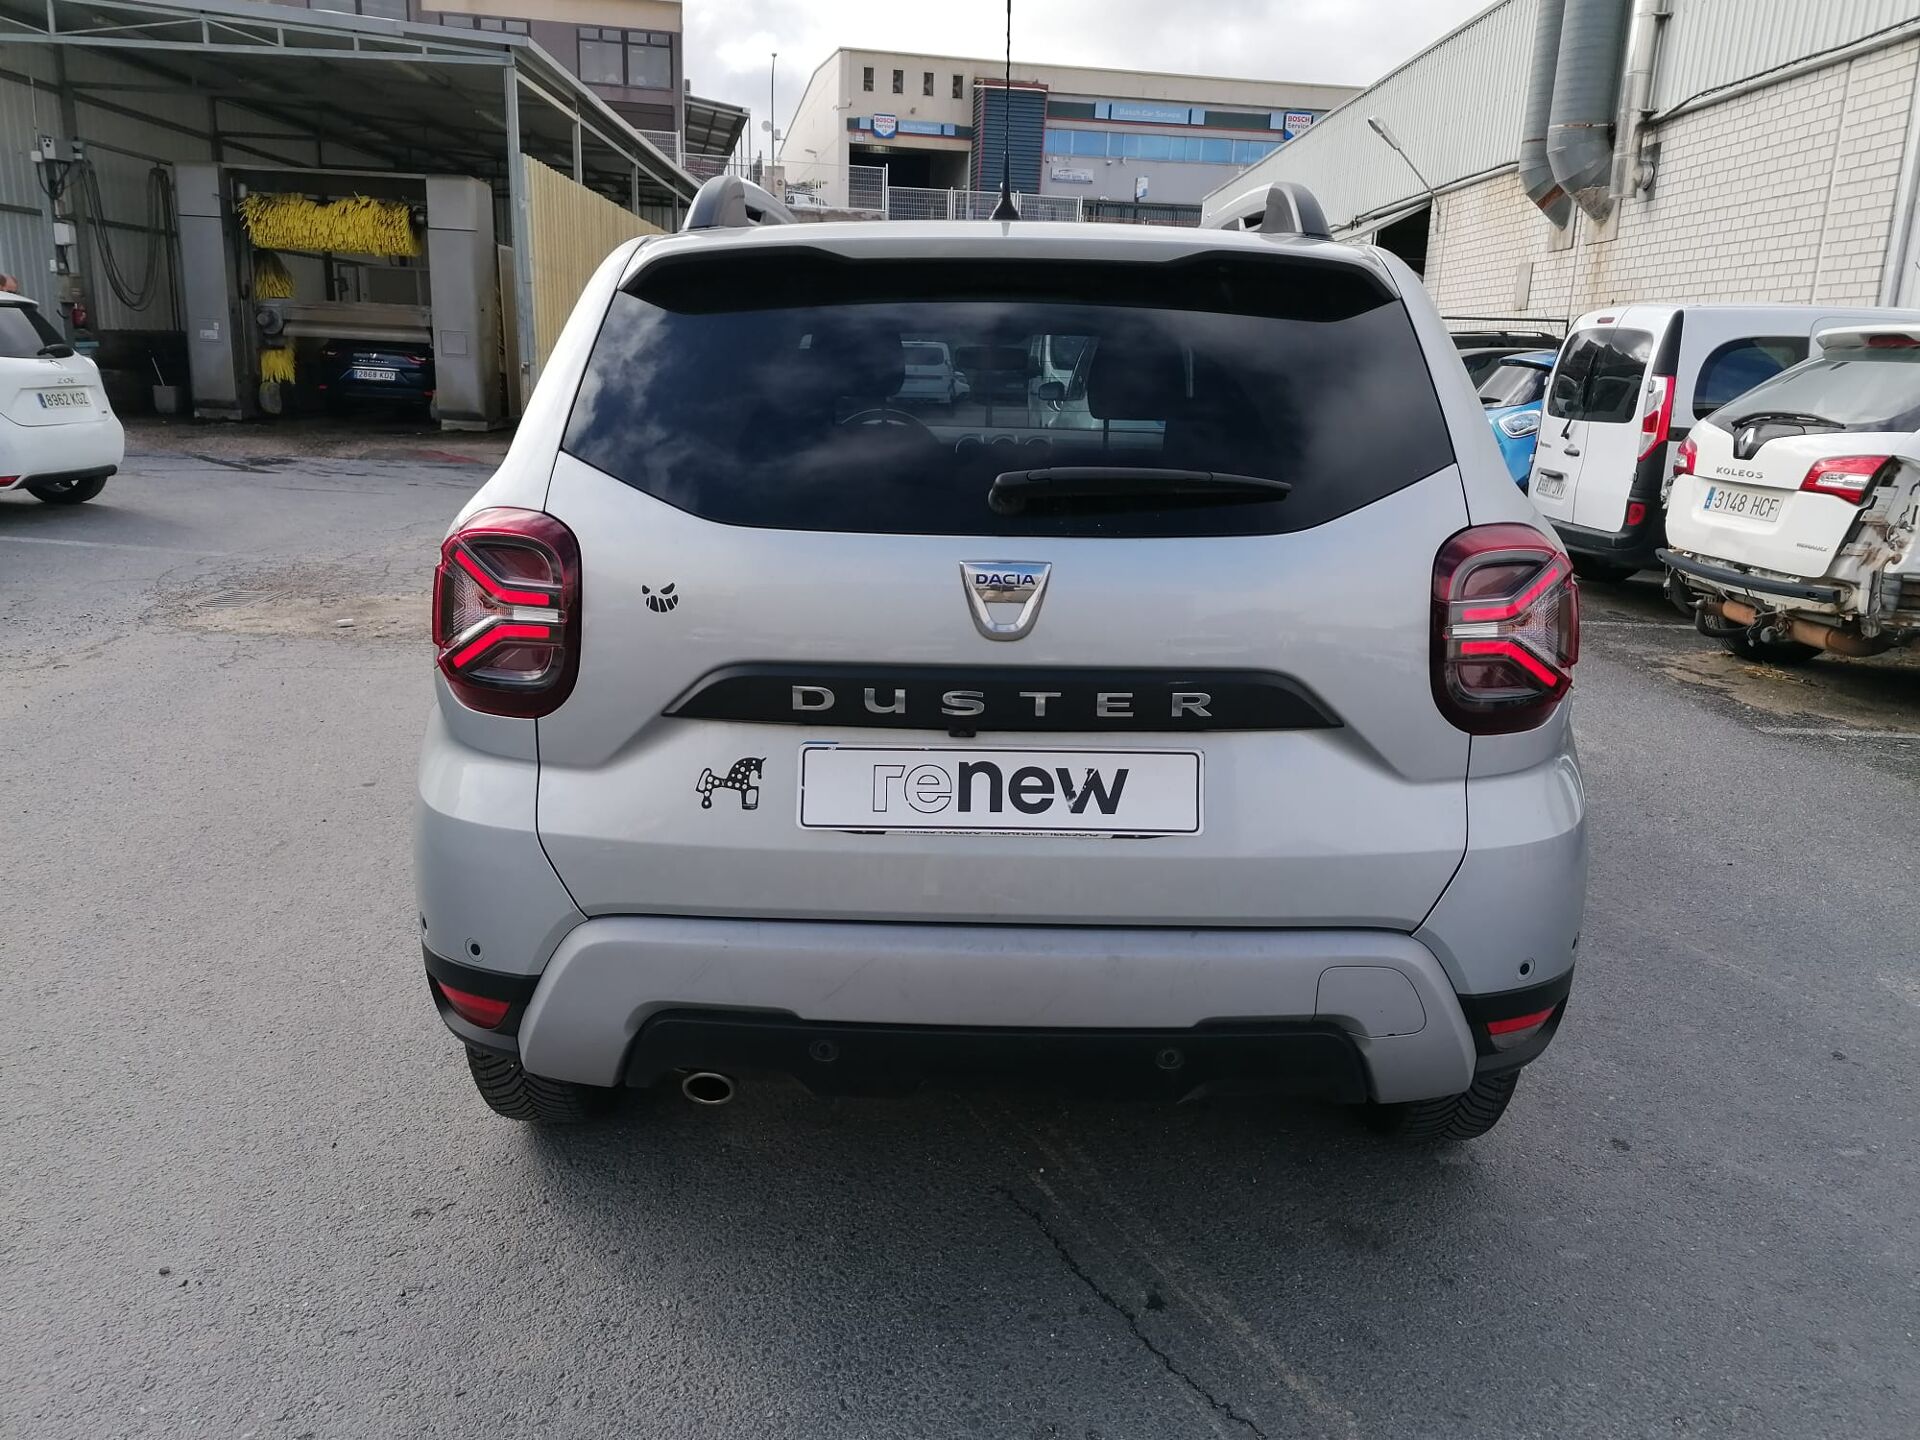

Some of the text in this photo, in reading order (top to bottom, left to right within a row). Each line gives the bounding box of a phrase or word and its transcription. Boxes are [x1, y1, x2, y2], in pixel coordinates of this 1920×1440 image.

[1287, 115, 1310, 123] BOSCH
[45, 393, 71, 407] 8962
[1715, 466, 1764, 479] KOLEOS
[1714, 490, 1780, 518] 3148 HCF
[975, 573, 1036, 586] DACIA
[790, 684, 1214, 719] DUSTER
[872, 760, 1130, 816] renew
